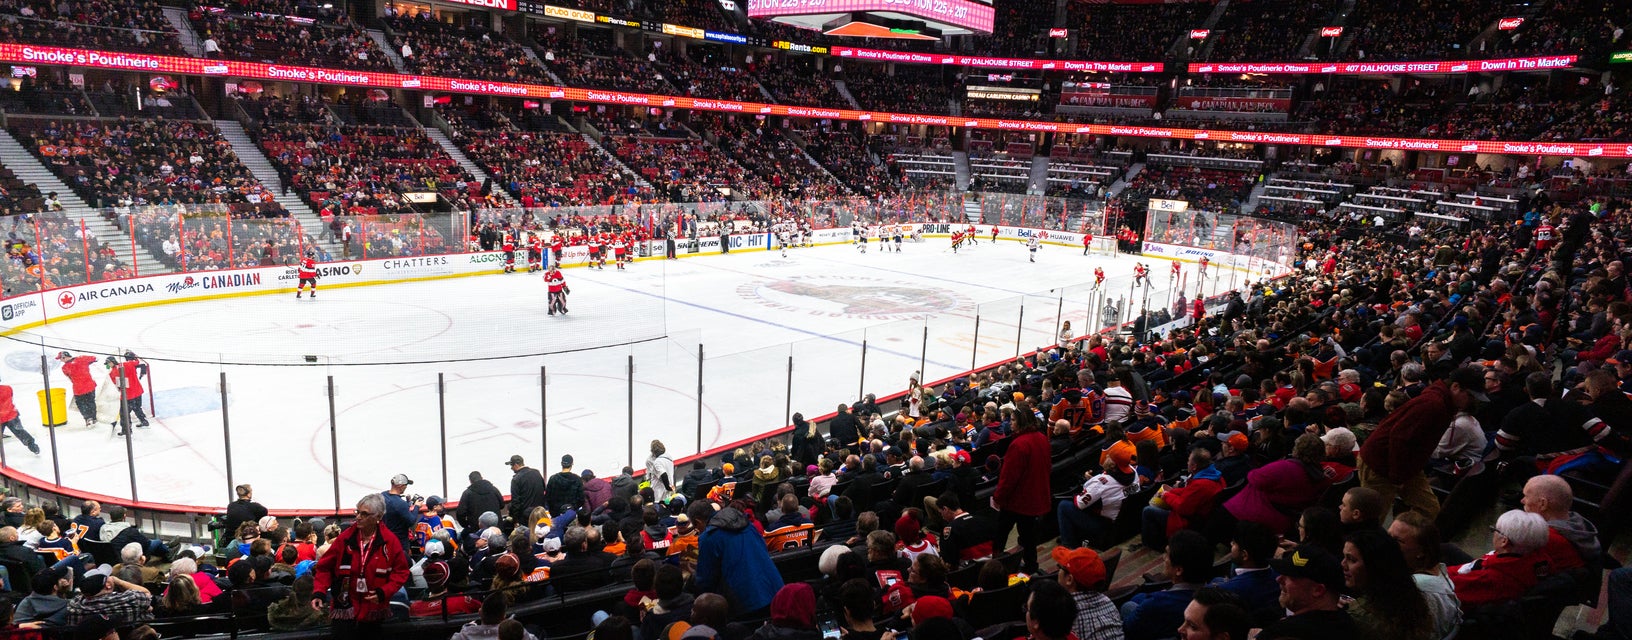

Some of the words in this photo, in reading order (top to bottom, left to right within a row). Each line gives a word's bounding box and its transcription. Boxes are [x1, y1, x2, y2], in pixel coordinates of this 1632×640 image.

[546, 7, 569, 17] aruba
[571, 10, 594, 20] aruba
[934, 0, 947, 14] 225
[954, 6, 968, 19] 207
[778, 41, 827, 53] RSRents.com
[23, 48, 87, 63] Smoke's
[89, 53, 159, 69] Poutinerie
[857, 50, 881, 59] Smoke's
[882, 52, 910, 62] Poutinerie
[911, 53, 932, 62] Ottawa
[972, 59, 1008, 67] DALHOUSIE
[1009, 60, 1034, 68] STREET
[1065, 61, 1085, 70] Down
[1108, 63, 1132, 71] Market
[1218, 64, 1247, 72] Smoke's
[1407, 63, 1440, 71] STREET
[1481, 61, 1506, 71] Down
[1507, 60, 1516, 69] In
[1517, 59, 1535, 68] The
[1537, 57, 1570, 68] Market
[268, 67, 315, 79] Smoke's
[317, 71, 368, 84] Poutinerie
[450, 81, 486, 92] Smoke's
[488, 84, 527, 96] Poutinerie
[587, 92, 617, 102] Smoke's
[617, 95, 648, 105] Poutinerie
[693, 101, 716, 110] Smoke's
[717, 102, 742, 111] Poutinerie
[812, 110, 840, 118] Poutinerie
[916, 116, 947, 125] Poutinerie
[998, 121, 1025, 129] Smoke's
[1025, 123, 1057, 131] Poutinerie
[1111, 127, 1138, 135] Smoke's
[1139, 128, 1172, 137] Poutinerie
[1231, 132, 1262, 141] Smoke's
[1263, 134, 1300, 143] Poutinerie
[1366, 139, 1399, 147] Smoke's
[1400, 140, 1438, 150] Poutinerie
[1504, 144, 1536, 153] Smoke's
[1536, 145, 1574, 154] Poutinerie
[1160, 200, 1175, 210] Bell
[1017, 228, 1033, 238] Bell
[1050, 234, 1075, 243] HUAWEI
[748, 235, 764, 249] HIT
[384, 257, 446, 272] CHATTERS
[203, 273, 260, 290] CANADIAN
[165, 281, 200, 295] Molson
[78, 292, 98, 304] AIR
[100, 284, 154, 300] CANADA
[14, 300, 37, 312] OFFICIAL
[14, 311, 26, 319] APP
